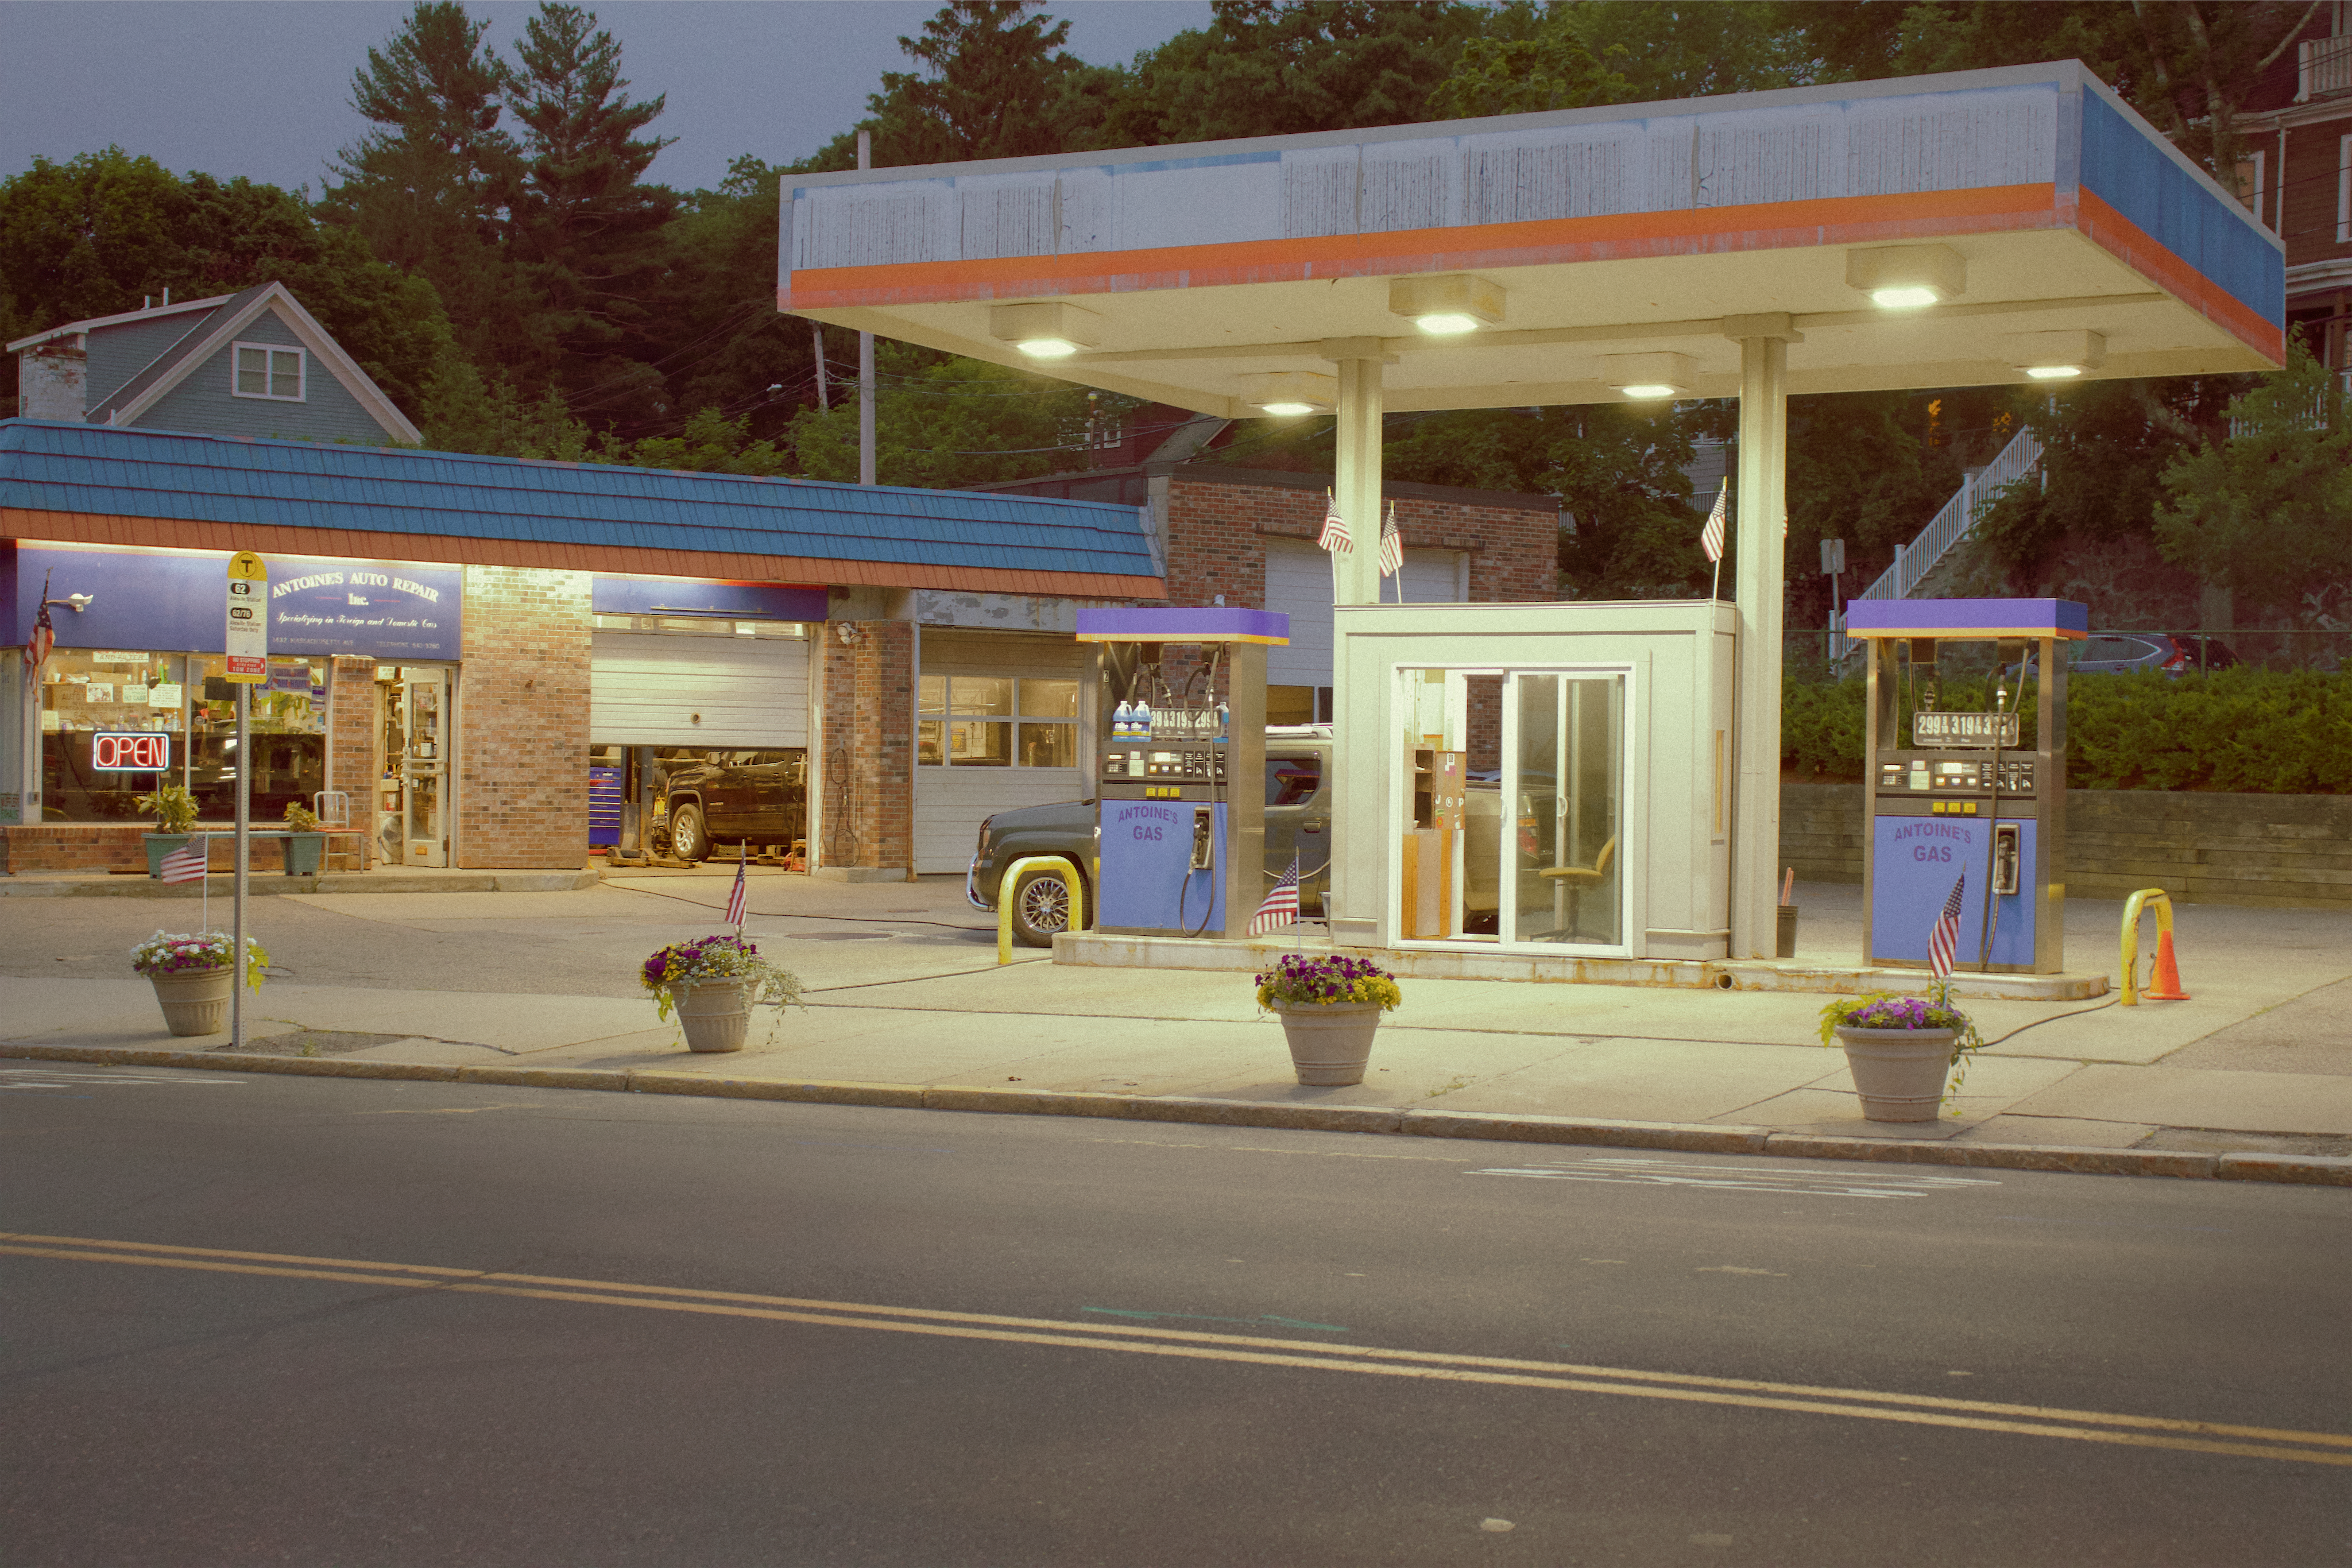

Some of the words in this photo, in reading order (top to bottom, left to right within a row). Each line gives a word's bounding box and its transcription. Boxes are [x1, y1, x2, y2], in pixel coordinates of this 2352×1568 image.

[241, 559, 253, 573] T
[235, 584, 246, 594] 62
[349, 572, 388, 586] AUTO
[392, 577, 439, 603] REPAIR
[347, 593, 369, 605] Inc.
[232, 609, 252, 618] 62/76
[277, 612, 323, 625] Specializing
[336, 615, 365, 626] Foreign
[386, 617, 419, 627] Domestic
[422, 619, 437, 628] Cars
[1918, 715, 1941, 734] 299
[1952, 715, 1974, 734] 319
[96, 737, 165, 766] OPEN
[1119, 806, 1178, 824] ANTOINE'S
[1134, 826, 1162, 841] GAS
[1895, 823, 1971, 843] ANTOINE'S
[1914, 845, 1951, 862] GAS
